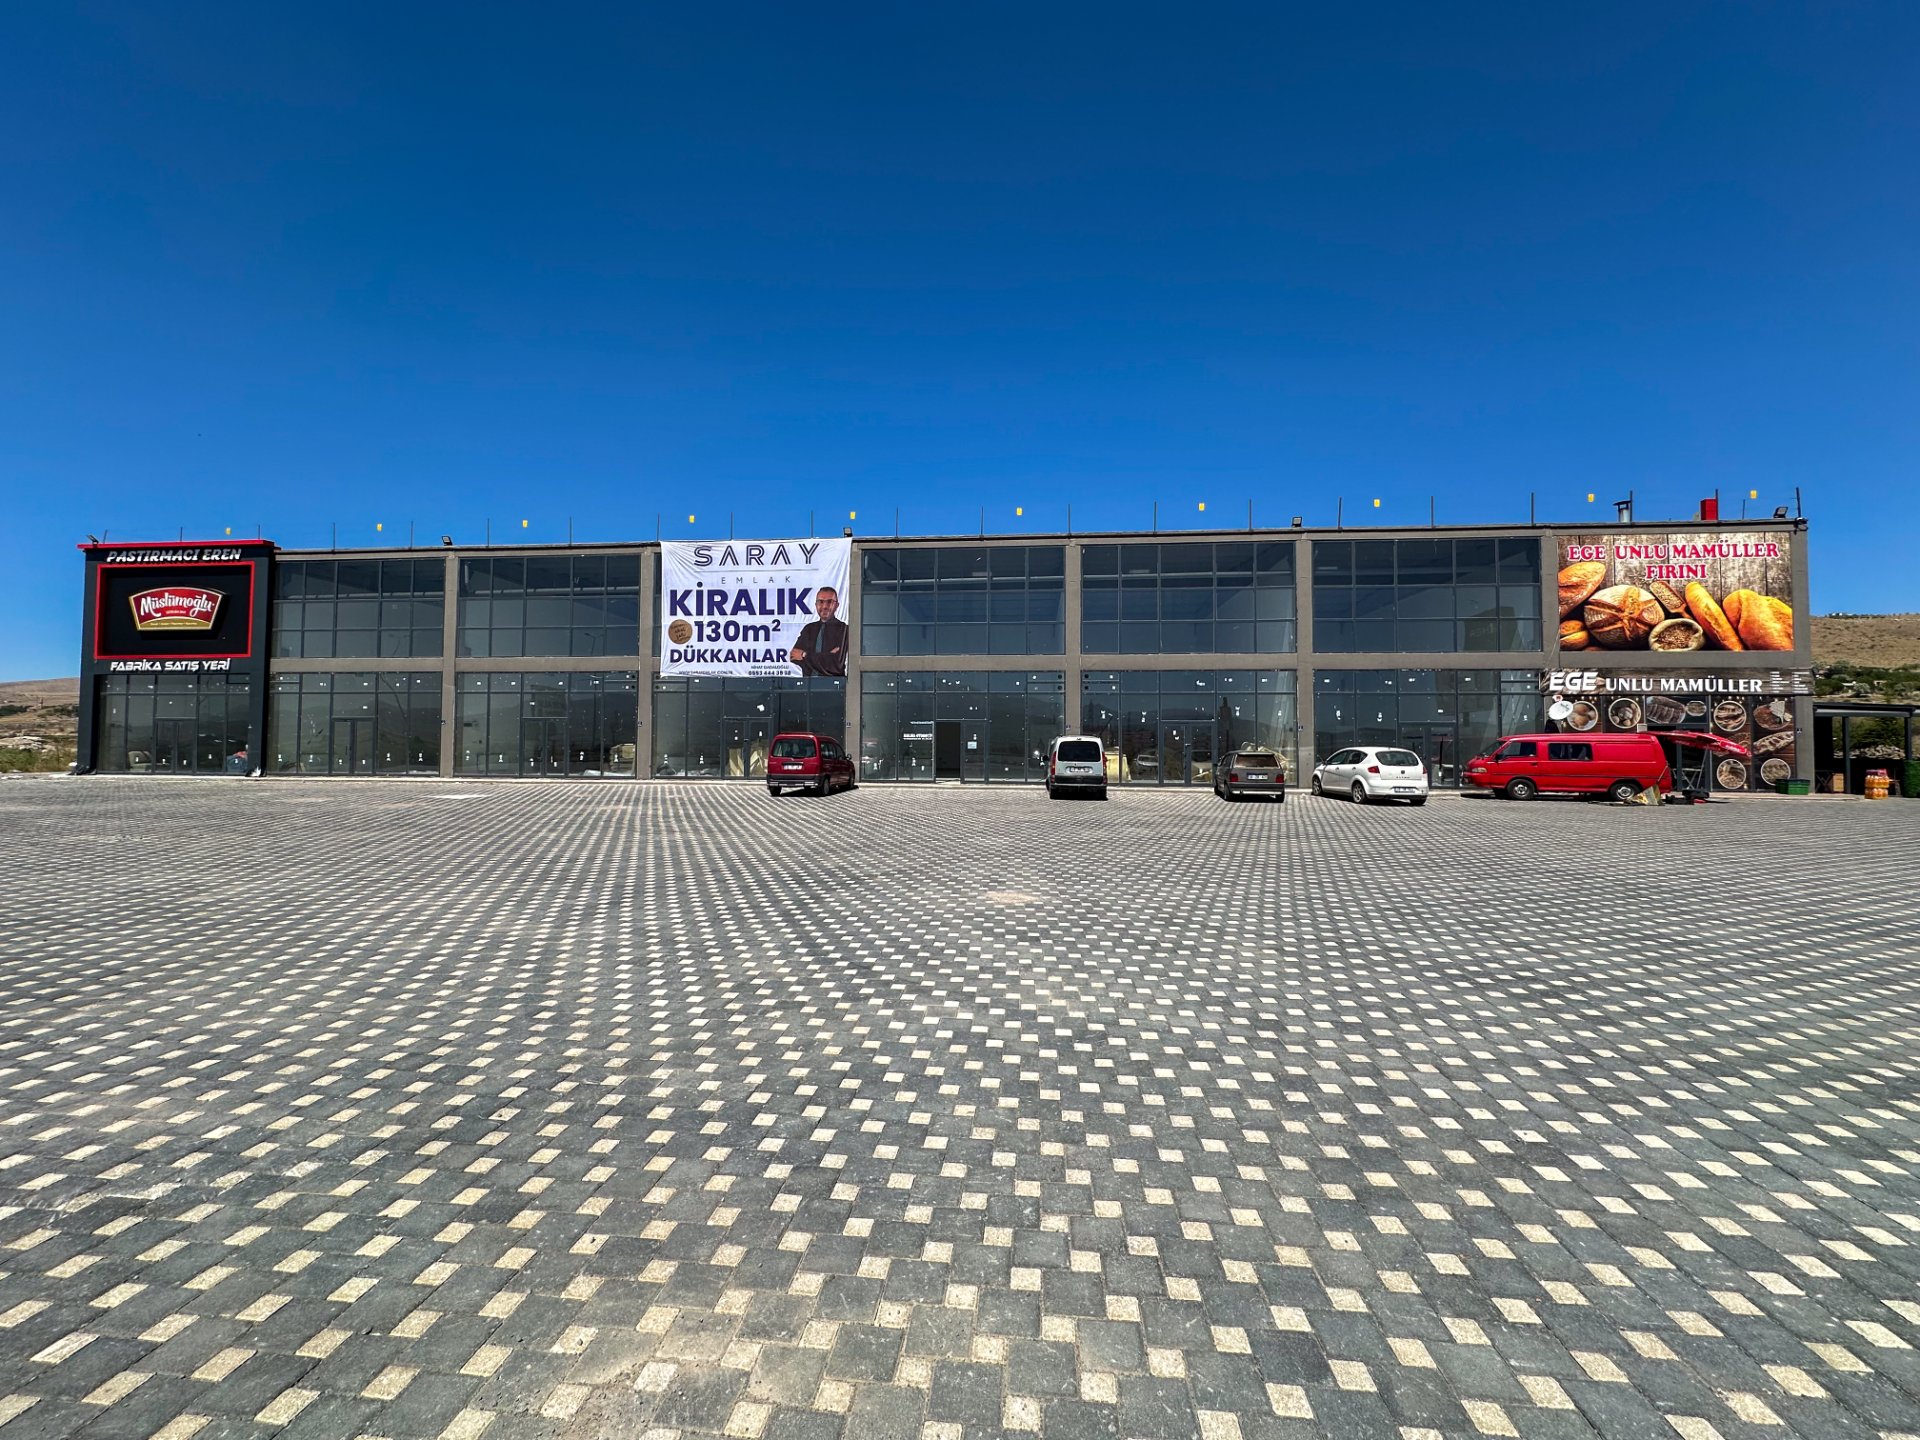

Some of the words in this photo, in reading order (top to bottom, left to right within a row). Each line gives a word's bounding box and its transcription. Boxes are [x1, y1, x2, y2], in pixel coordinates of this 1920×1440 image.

[107, 550, 199, 562] PASTIRMACI
[202, 549, 241, 560] EREN
[693, 543, 820, 567] SARAY
[1567, 545, 1606, 560] EGE
[1614, 544, 1668, 560] UNLU
[1671, 539, 1780, 559] MAMÜLLER
[721, 576, 792, 585] EMLAK
[1645, 563, 1708, 580] FIRINI
[140, 592, 213, 617] Müslümoğlu
[670, 582, 813, 616] KİRALIK
[670, 645, 788, 663] DÜKKANLAR
[110, 659, 162, 671] FABRİKA
[164, 660, 200, 672] SATIŞ
[202, 658, 231, 671] YERİ
[1549, 671, 1599, 691] EGE
[1605, 677, 1653, 692] UNLU
[1660, 674, 1763, 692] MAMÜLLER
